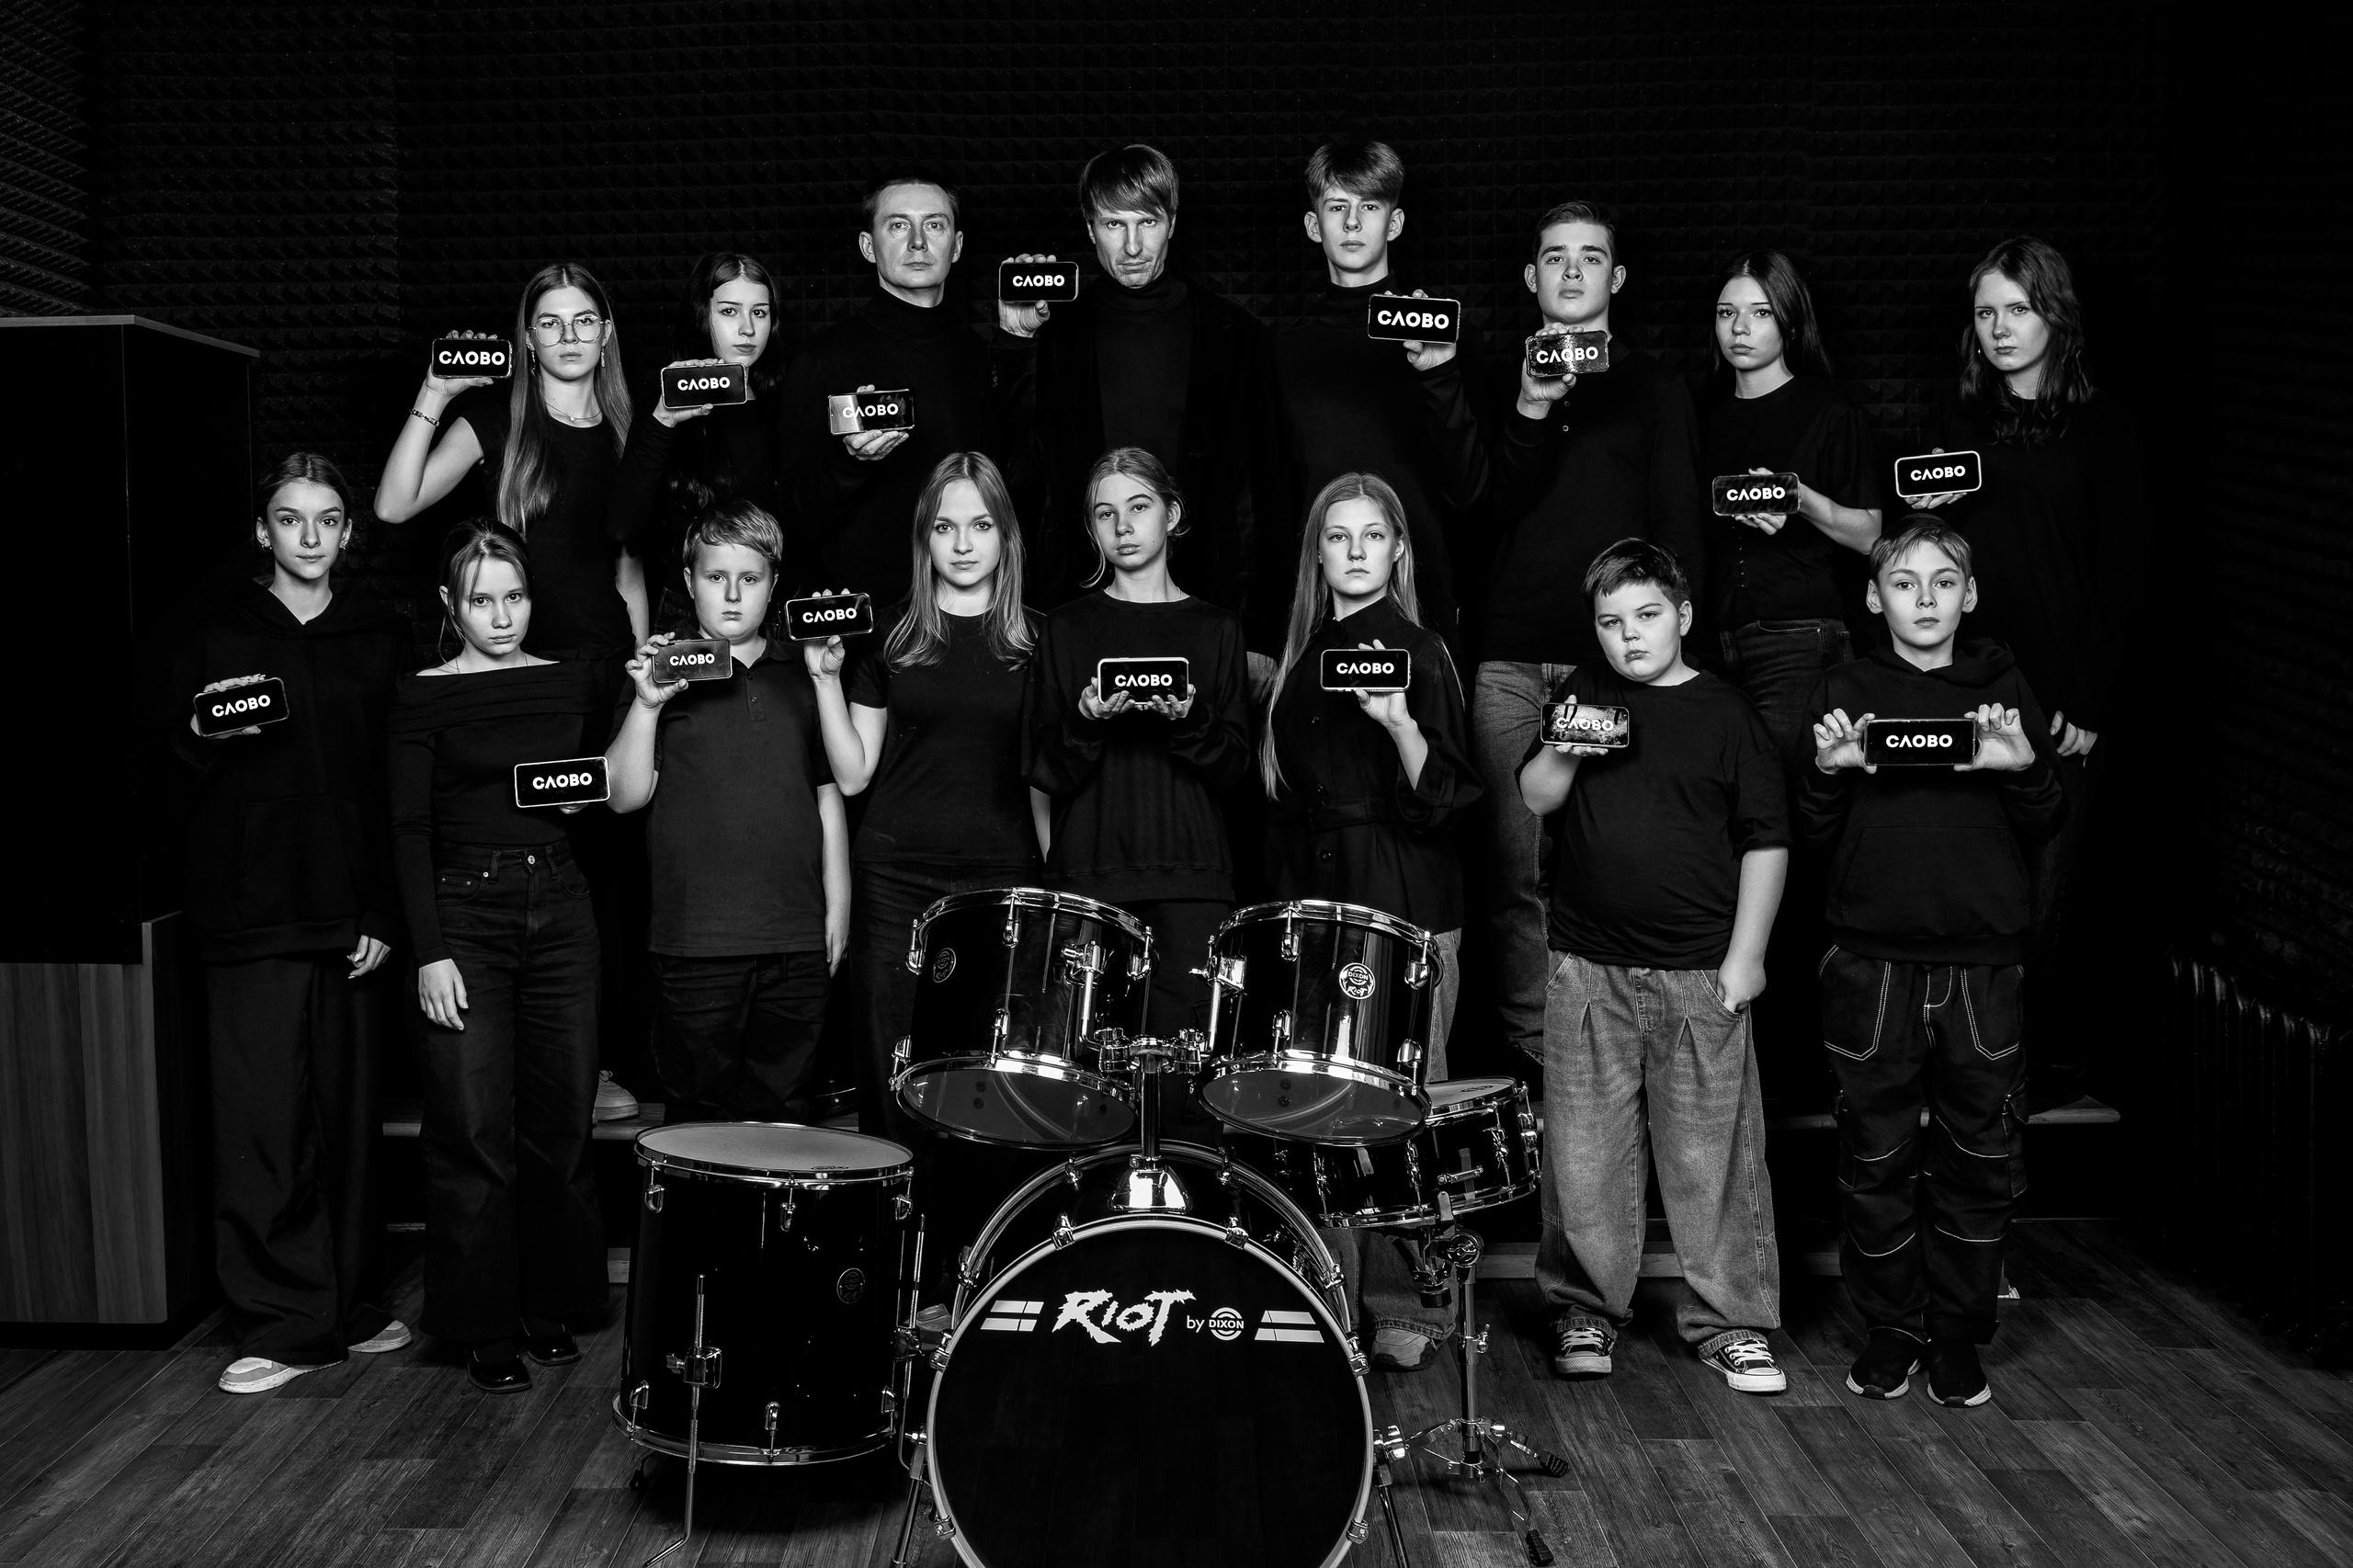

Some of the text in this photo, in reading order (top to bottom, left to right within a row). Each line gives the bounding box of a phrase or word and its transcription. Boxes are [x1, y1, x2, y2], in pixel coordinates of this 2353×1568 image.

[1347, 971, 1369, 981] DIXON
[1187, 1315, 1205, 1333] by
[1208, 1318, 1245, 1329] DIXON
